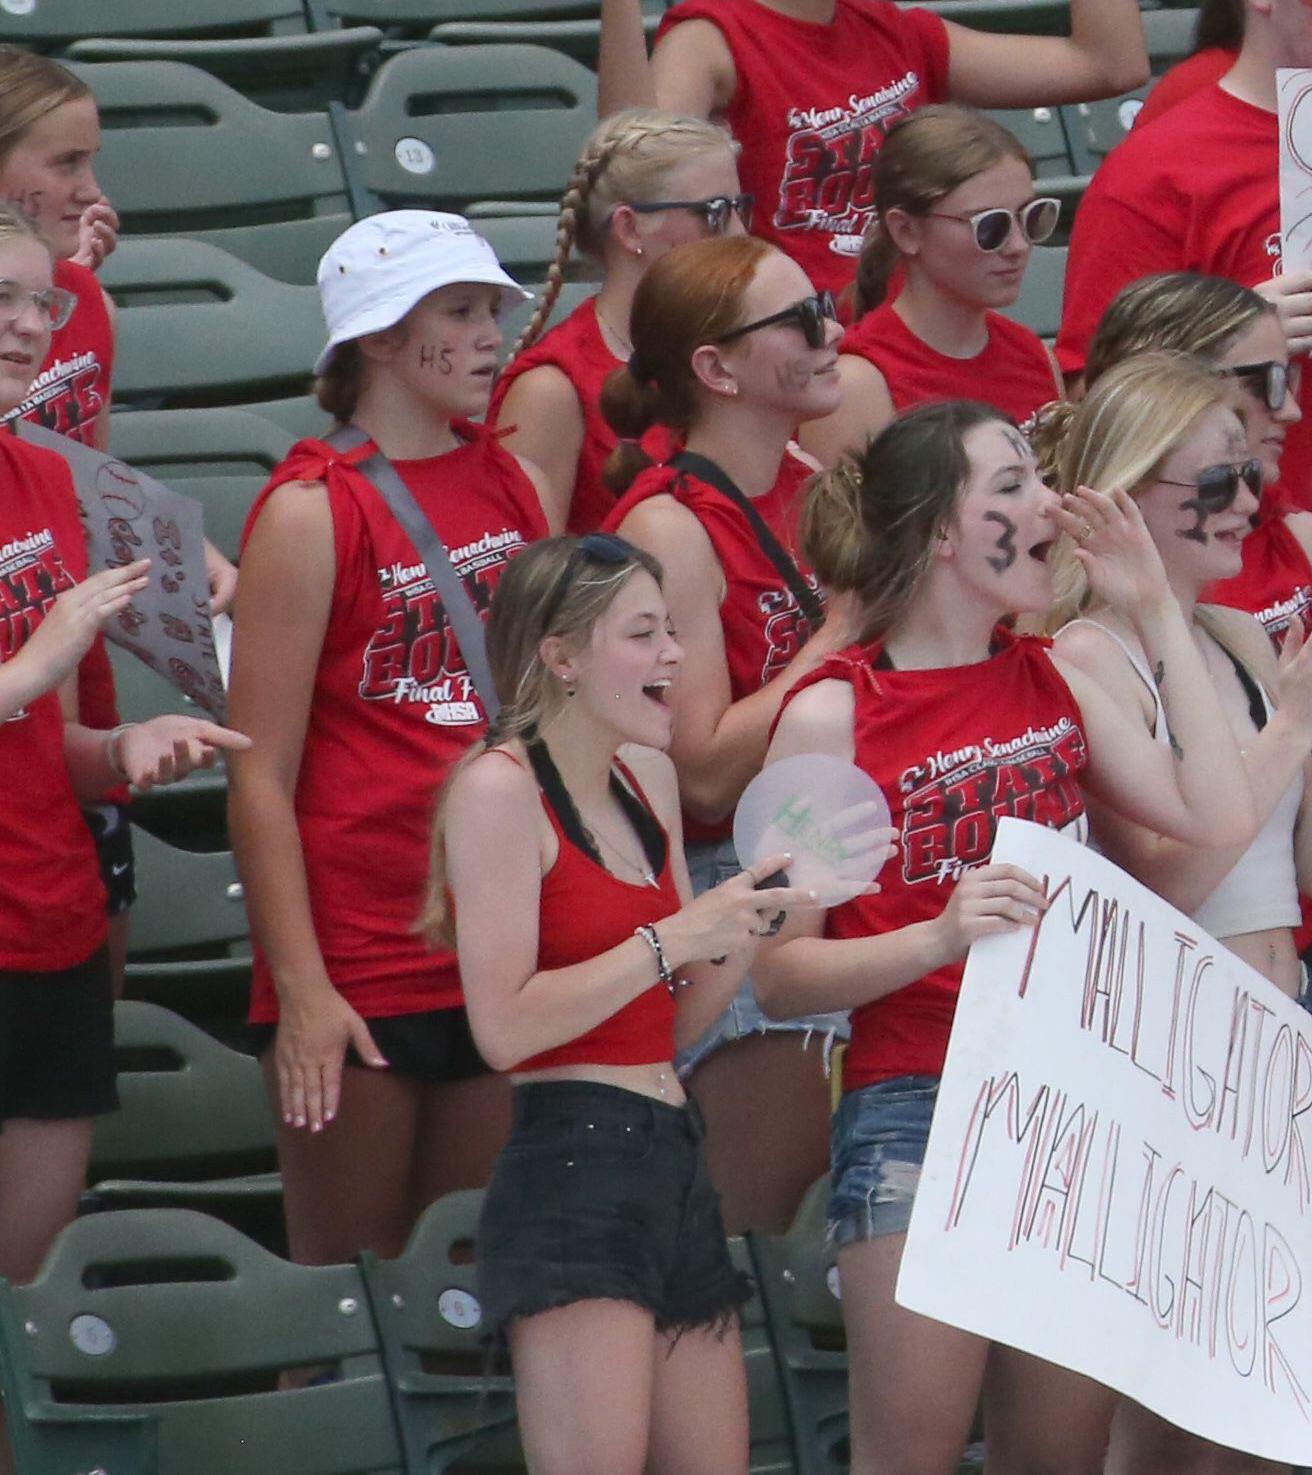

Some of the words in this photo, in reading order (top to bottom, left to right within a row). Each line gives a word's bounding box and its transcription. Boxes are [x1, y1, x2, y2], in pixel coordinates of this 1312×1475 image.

[804, 209, 861, 234] Final
[983, 510, 1018, 574] 3
[393, 677, 454, 703] Final
[926, 715, 1072, 778] Henry-Senachwine
[904, 726, 1086, 832] STATE
